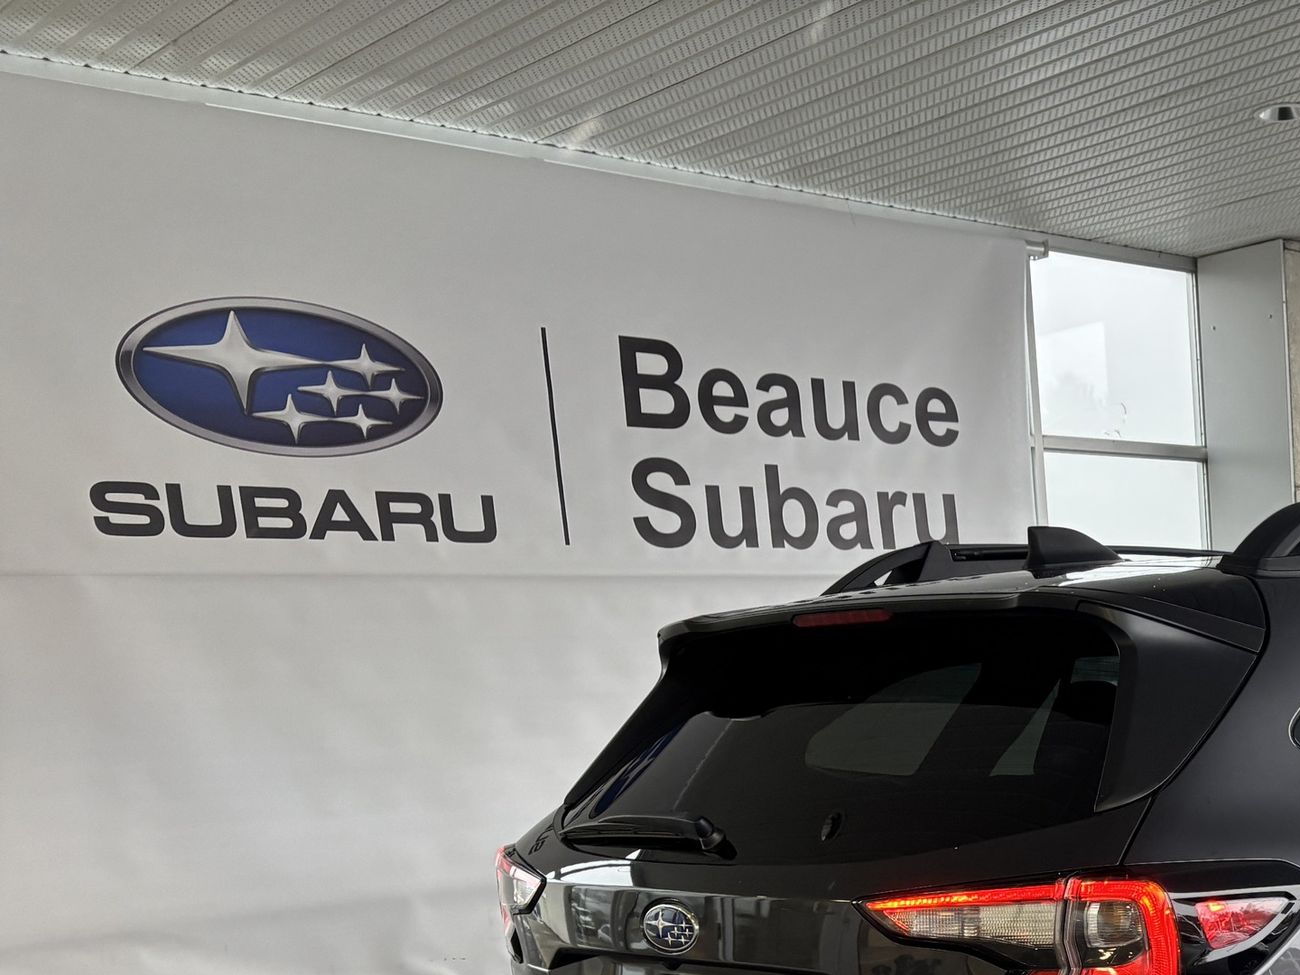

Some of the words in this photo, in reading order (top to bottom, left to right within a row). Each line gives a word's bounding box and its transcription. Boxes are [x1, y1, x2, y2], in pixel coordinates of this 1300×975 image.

[617, 334, 960, 448] Beauce
[89, 480, 498, 544] SUBARU
[630, 456, 960, 550] Subaru
